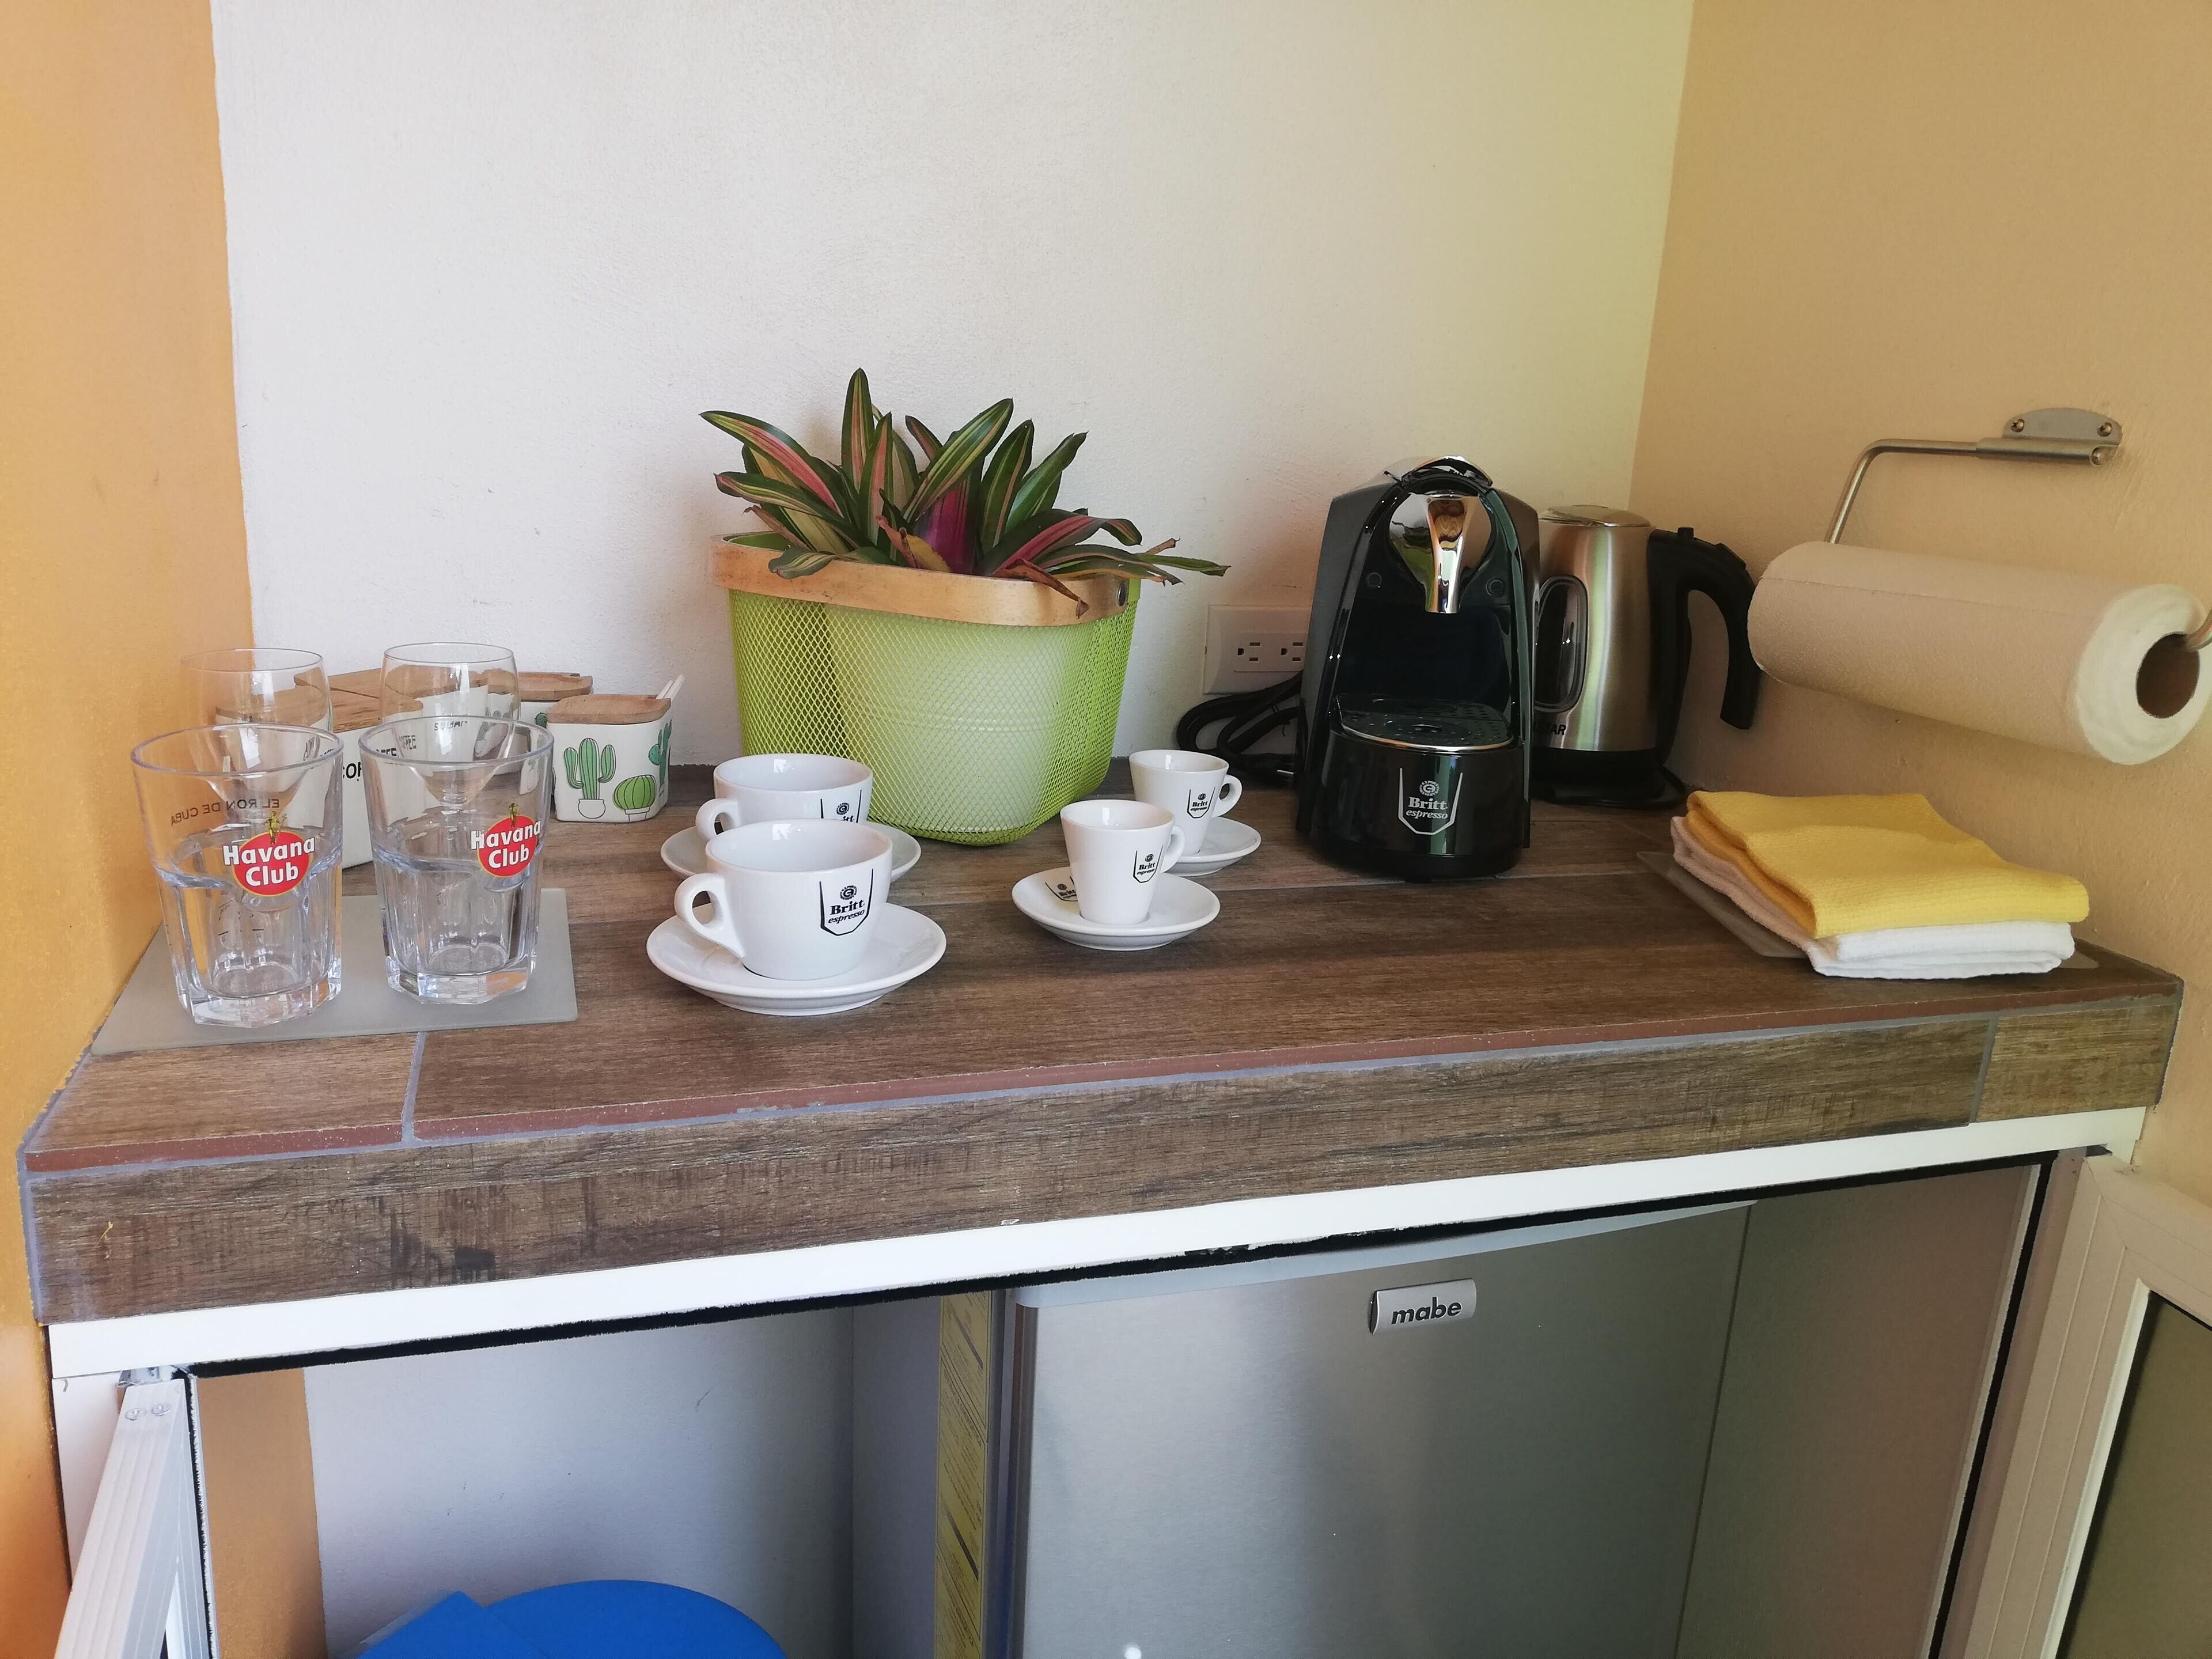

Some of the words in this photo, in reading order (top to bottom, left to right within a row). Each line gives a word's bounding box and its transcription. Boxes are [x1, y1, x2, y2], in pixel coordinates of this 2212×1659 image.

[1406, 809, 1448, 819] espresso
[1408, 797, 1448, 810] Britt
[471, 820, 541, 850] Havana
[222, 837, 316, 866] Havana
[488, 844, 530, 869] Club
[245, 862, 299, 887] Club
[828, 910, 865, 924] espresso
[830, 899, 865, 915] Britt
[1391, 1296, 1461, 1324] mabe
